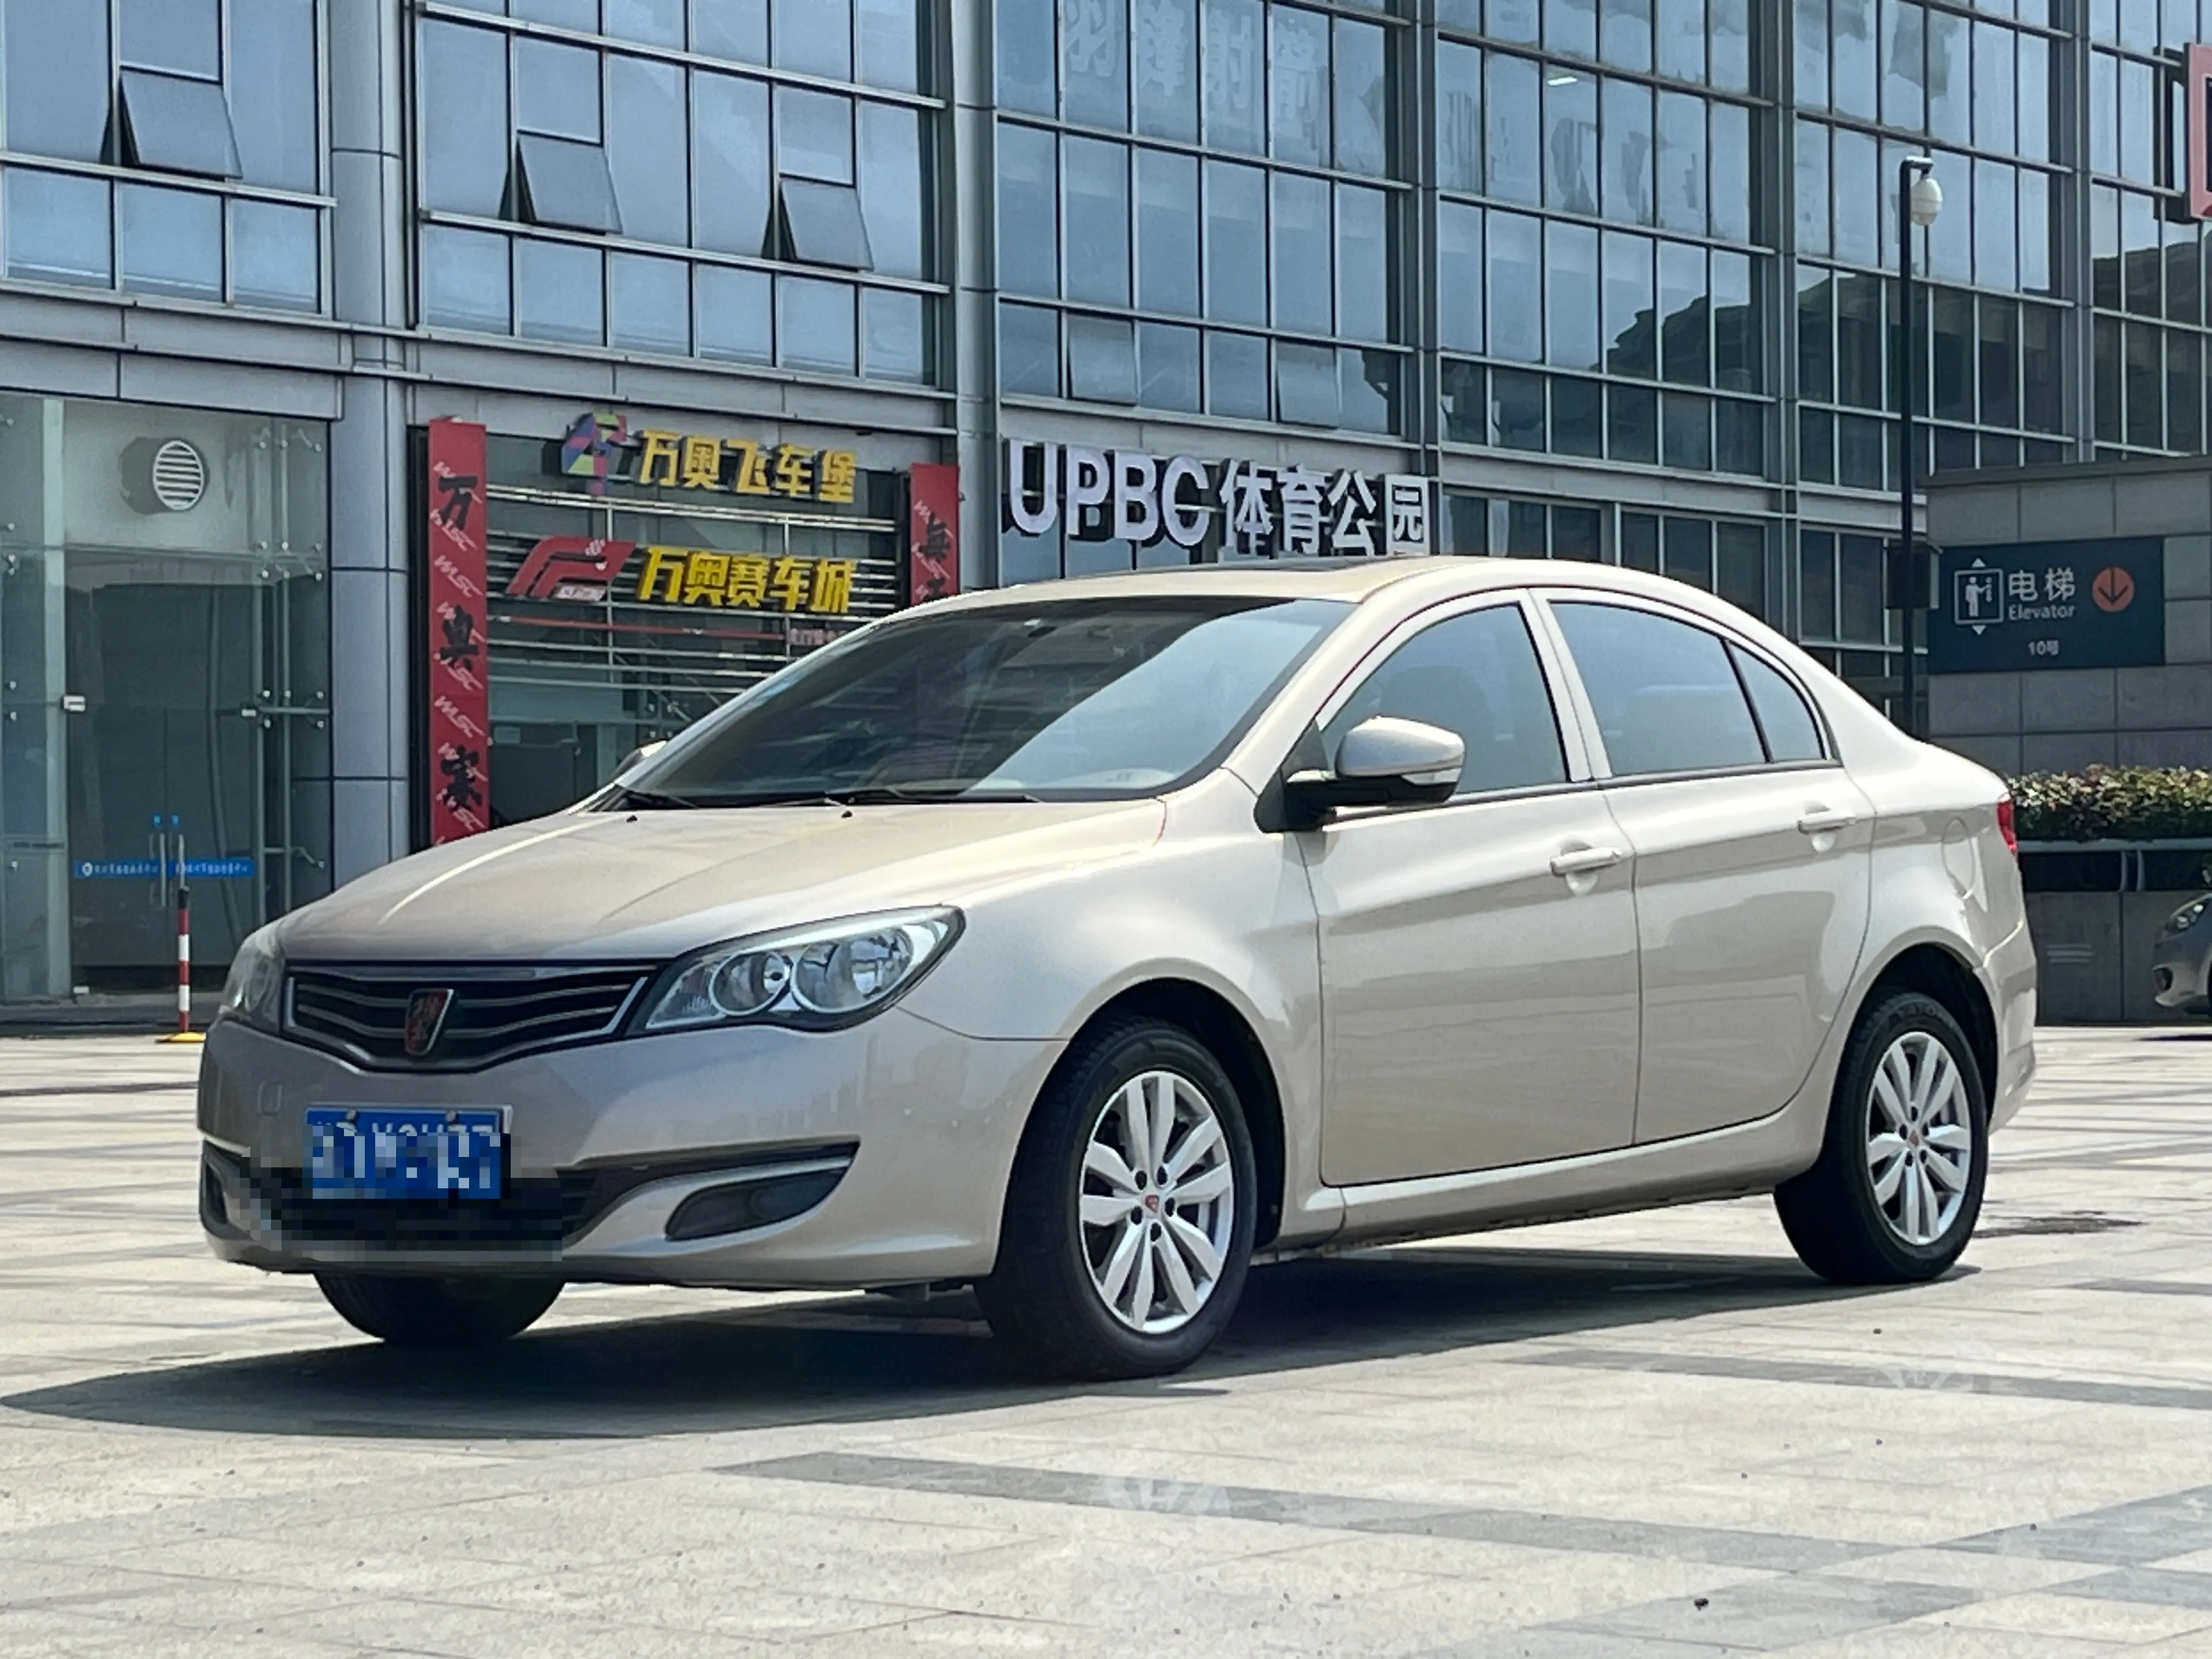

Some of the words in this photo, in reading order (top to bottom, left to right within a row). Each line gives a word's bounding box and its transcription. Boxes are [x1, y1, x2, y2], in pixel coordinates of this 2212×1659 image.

[639, 429, 856, 503] 万奥飞车堡
[1009, 439, 1209, 546] UPBC
[1220, 458, 1430, 558] 体育公园
[638, 545, 856, 613] 万奥赛车城
[2009, 567, 2075, 601] 电梯
[2009, 603, 2075, 620] Elevator
[2028, 639, 2059, 656] 10号
